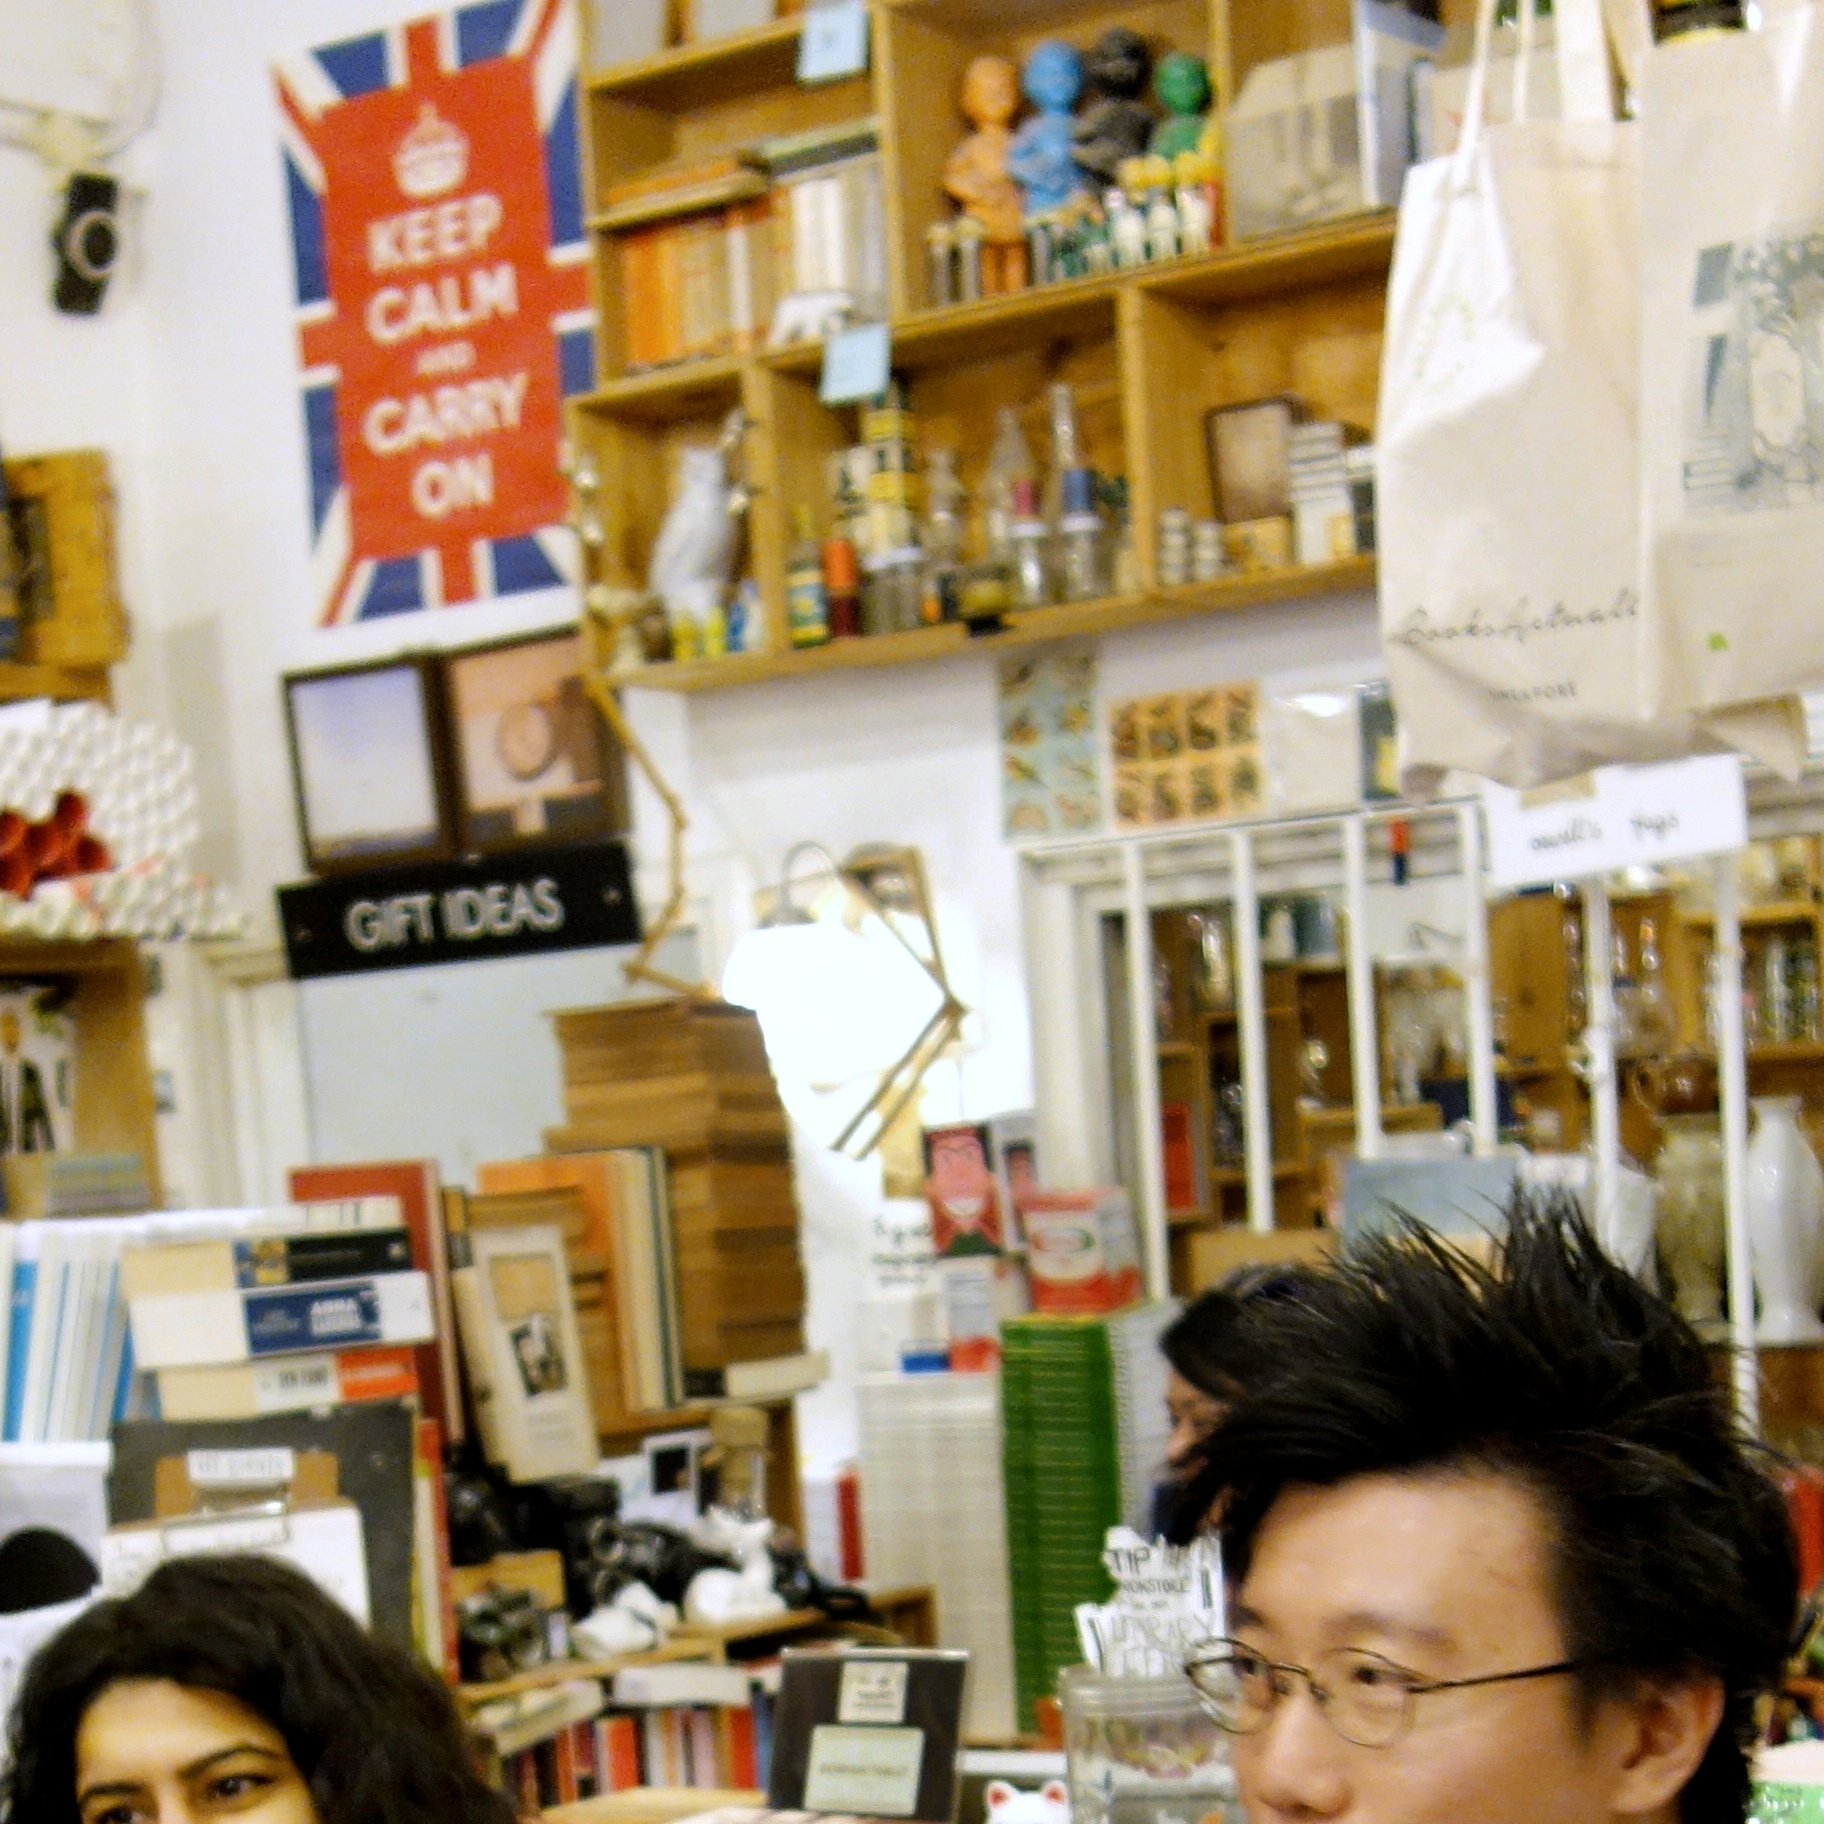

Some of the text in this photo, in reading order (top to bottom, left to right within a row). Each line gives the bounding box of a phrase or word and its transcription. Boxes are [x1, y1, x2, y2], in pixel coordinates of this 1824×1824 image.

[366, 193, 504, 274] KEEP
[364, 262, 520, 344] CALM
[414, 342, 475, 375] AND
[362, 371, 528, 456] CARRY
[411, 453, 495, 518] ON
[344, 876, 566, 952] GIFT IDEAS
